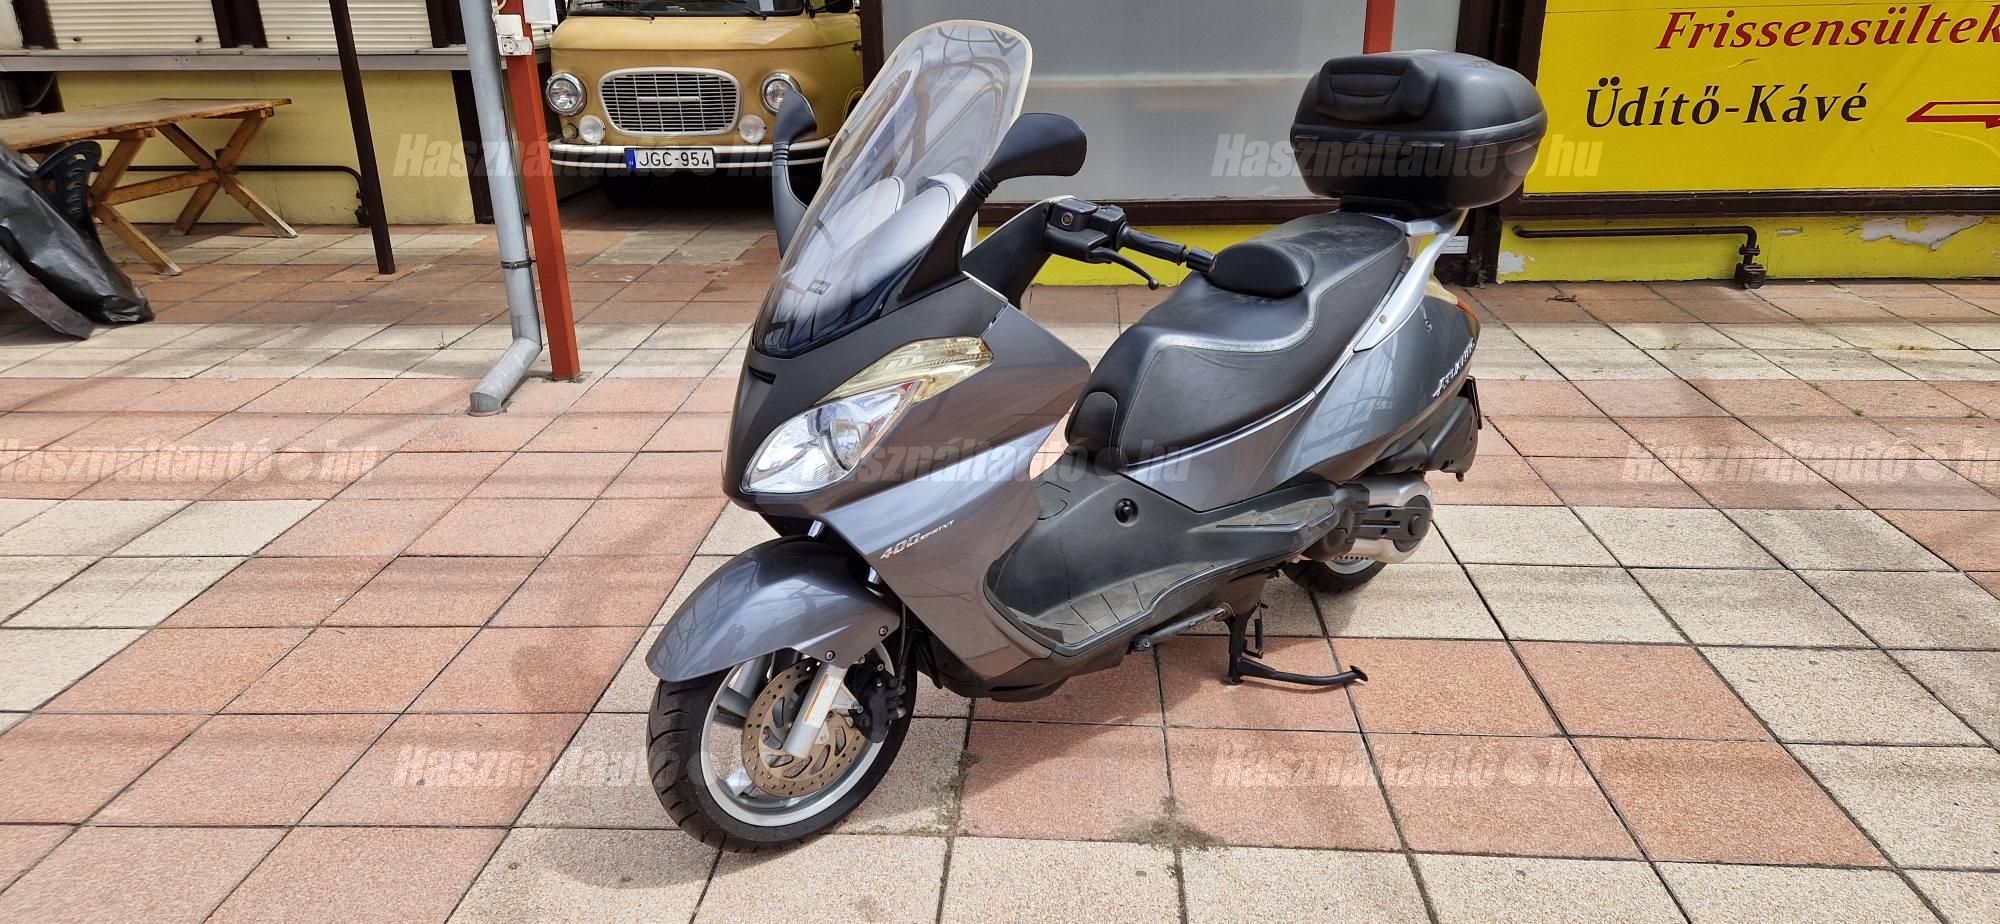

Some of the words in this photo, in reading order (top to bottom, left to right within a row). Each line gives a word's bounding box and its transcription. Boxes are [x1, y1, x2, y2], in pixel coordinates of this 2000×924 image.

[1655, 4, 2000, 49] Frissensültek
[1586, 76, 1867, 128] Üdítő-Kávé
[639, 151, 709, 167] JGC-954
[880, 532, 921, 560] 400
